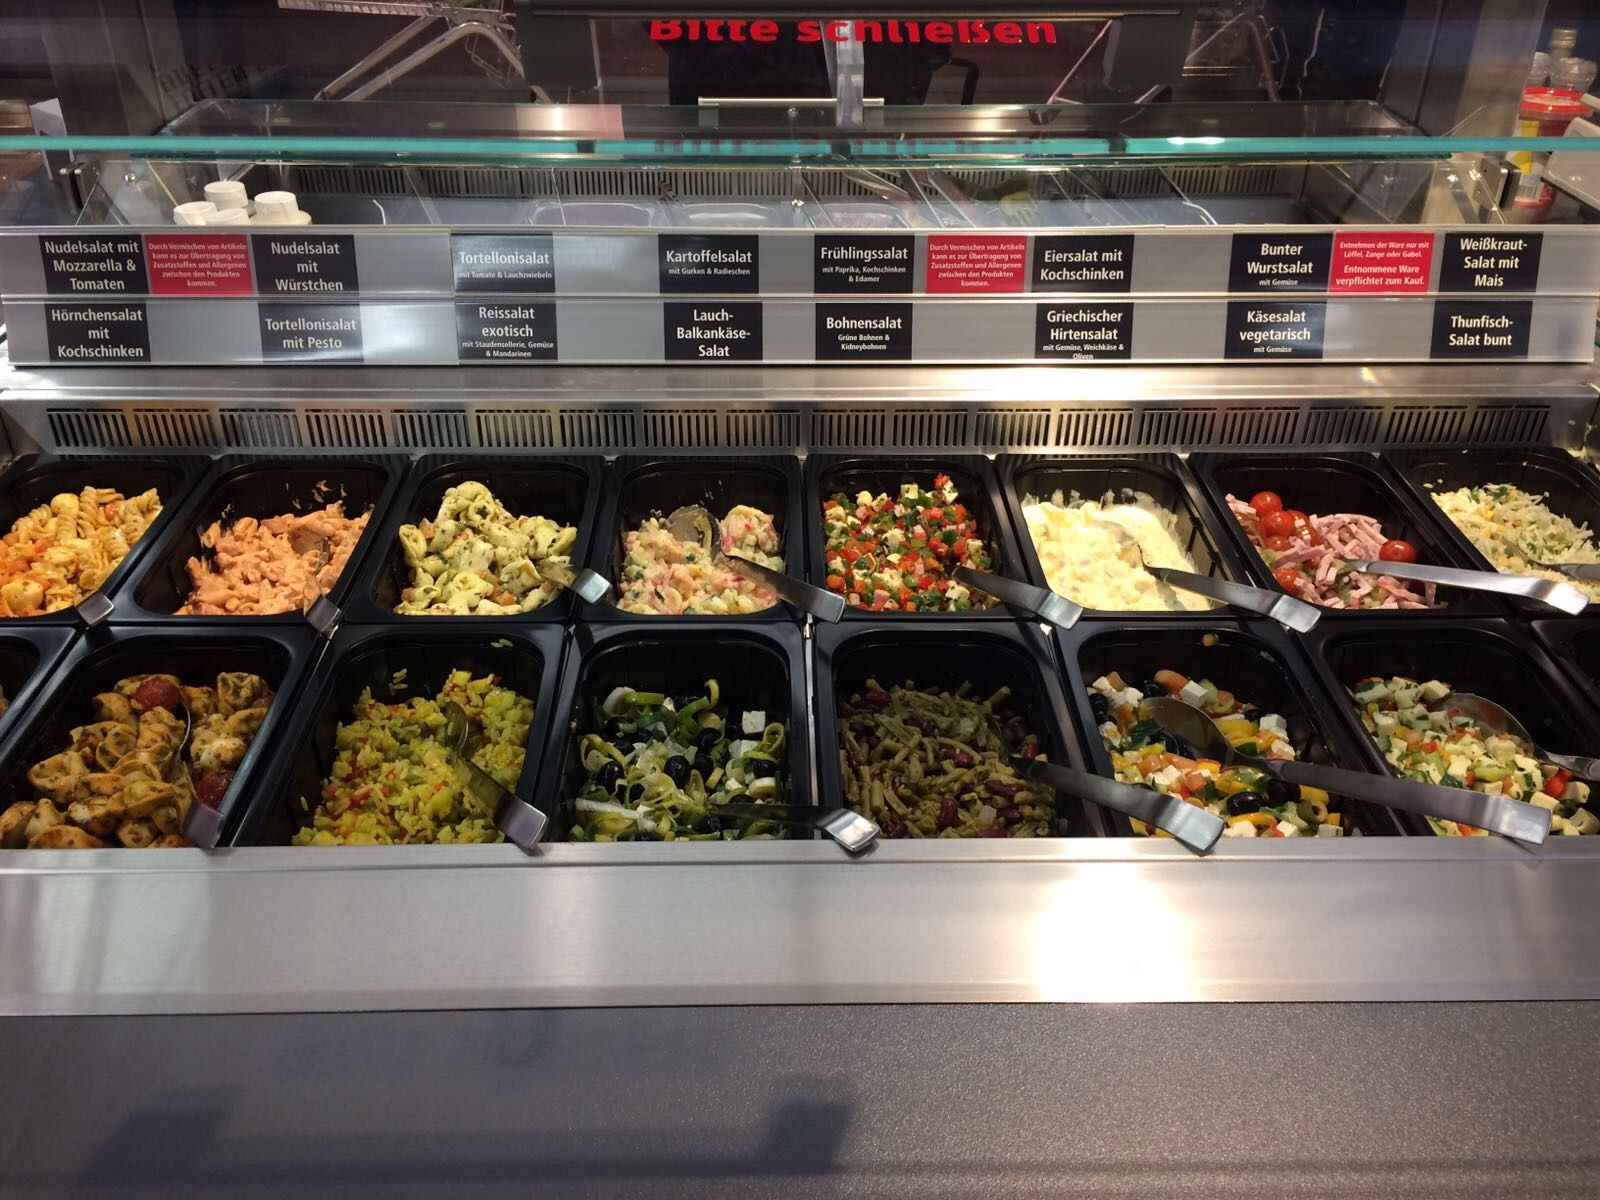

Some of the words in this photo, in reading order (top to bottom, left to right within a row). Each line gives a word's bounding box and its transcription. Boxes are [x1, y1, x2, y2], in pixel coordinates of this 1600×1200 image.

[650, 20, 779, 43] Bitte
[797, 20, 1057, 43] schließen
[45, 241, 114, 253] Nudelsalat
[118, 241, 139, 253] mit
[271, 241, 340, 254] Nudelsalat
[1261, 243, 1303, 255] Bunter
[1460, 238, 1527, 250] Weißkraut-
[191, 252, 231, 260] Übertragung
[459, 251, 549, 264] Tortellonisalat
[666, 250, 752, 262] Kartoffelsalat
[821, 246, 908, 262] Frühlingssalat
[969, 252, 1008, 261] Übertragung
[1045, 249, 1098, 262] Eiersalat
[1102, 249, 1123, 261] mit
[1365, 251, 1385, 259] Zange
[54, 260, 122, 272] Mozzarella
[127, 260, 136, 271] &
[297, 260, 318, 273] mit
[988, 262, 1022, 270] Allergenen
[1247, 261, 1313, 273] Wurstsalat
[1464, 256, 1495, 268] Salat
[1499, 256, 1519, 268] mit
[835, 266, 861, 274] Paprika,
[1041, 268, 1124, 280] Kochschinken
[1344, 265, 1397, 273] Entnommene
[1399, 265, 1419, 273] Ware
[70, 278, 125, 290] Tomaten
[275, 278, 343, 291] Würstchen
[1336, 276, 1383, 286] verpflichtet
[1404, 276, 1424, 284] Kauf.
[1475, 275, 1504, 287] Mais
[52, 309, 142, 321] Hörnchensalat
[479, 307, 535, 319] Reissalat
[694, 309, 733, 321] Lauch-
[1047, 310, 1123, 322] Griechischer
[1247, 310, 1306, 322] Käsesalat
[265, 318, 356, 331] Tortellonisalat
[826, 316, 902, 329] Bohnensalat
[1451, 315, 1513, 328] Thunfisch-
[88, 328, 109, 339] mit
[482, 324, 533, 337] exotisch
[677, 326, 751, 339] Balkankäse-
[1051, 328, 1118, 340] Hirtensalat
[1240, 328, 1310, 343] vegetarisch
[283, 337, 304, 348] mit
[308, 337, 342, 348] Pesto
[1449, 333, 1480, 346] Salat
[1484, 333, 1512, 345] bunt
[58, 345, 143, 357] Kochschinken
[699, 345, 730, 356] Salat
[841, 343, 886, 351] Kidneybohnen
